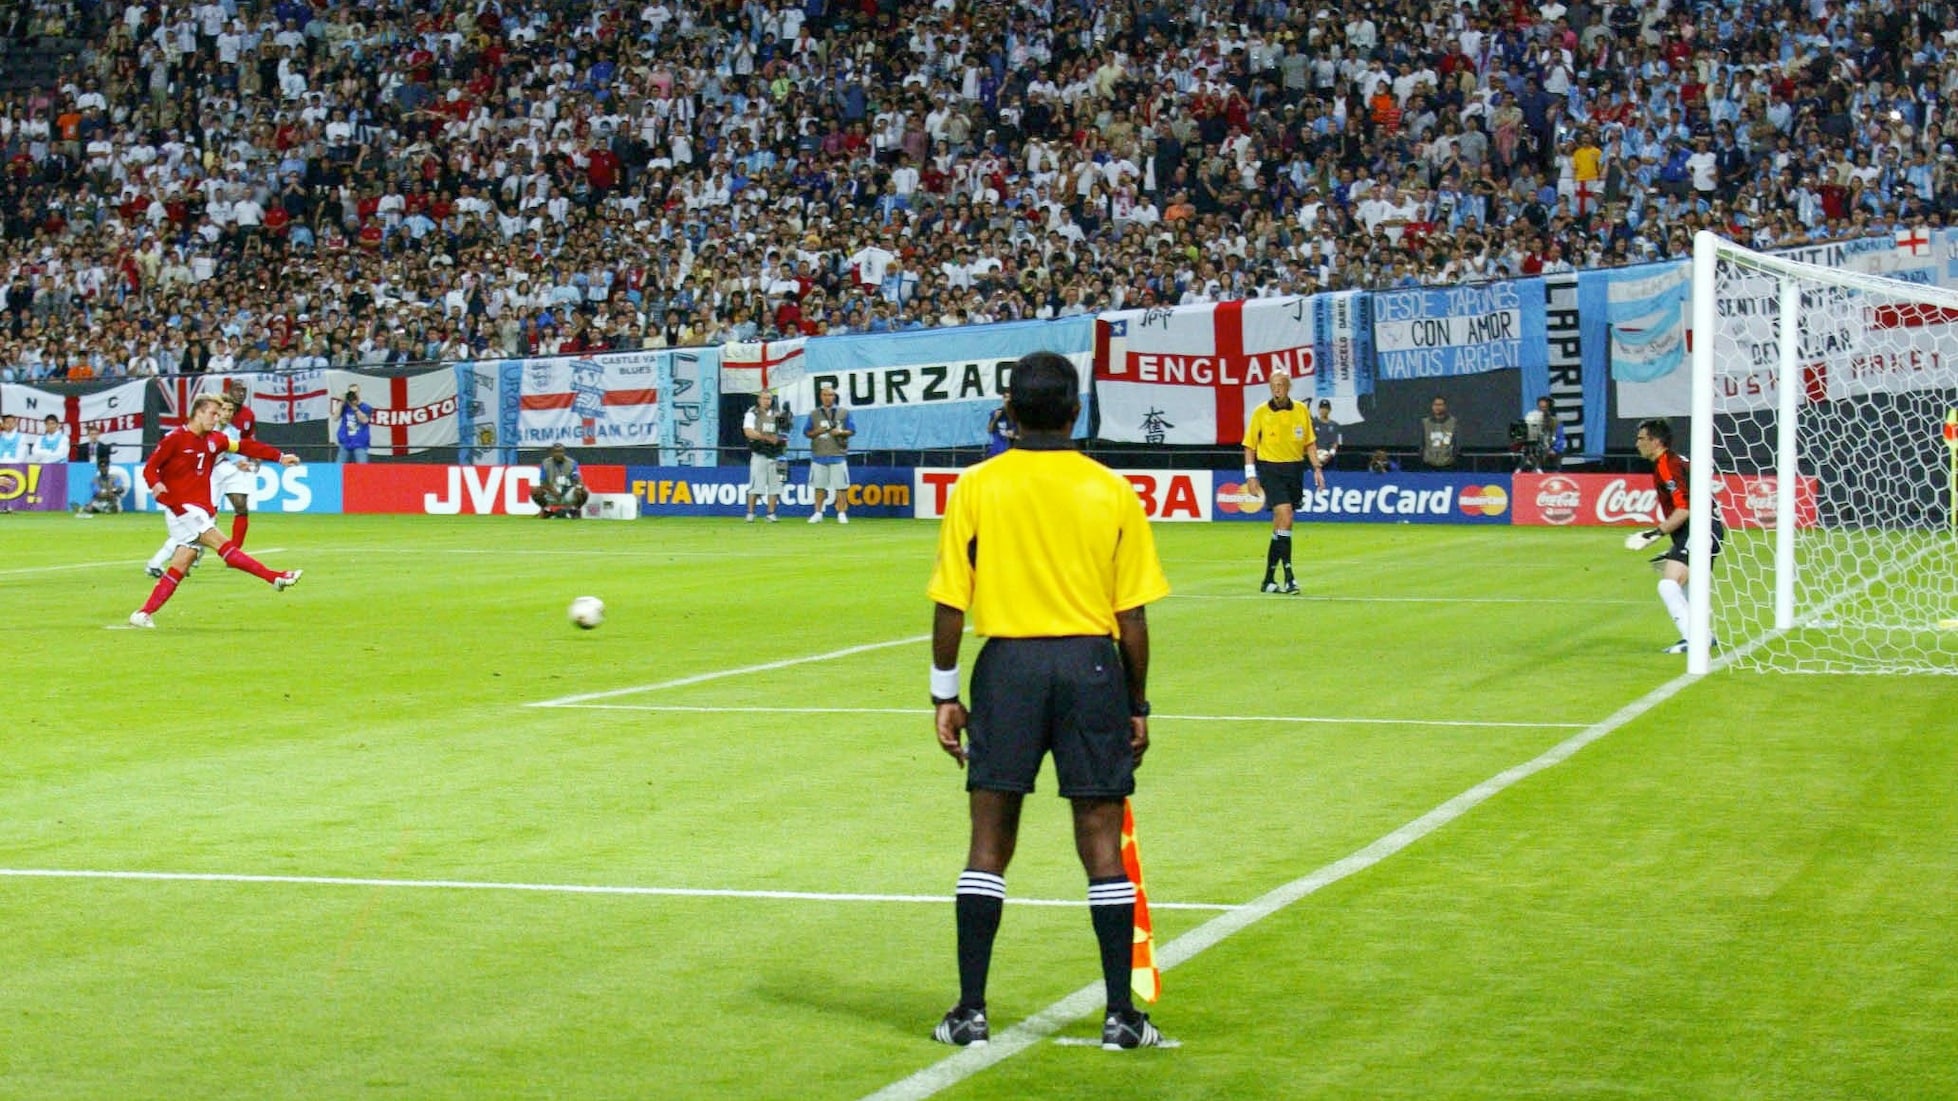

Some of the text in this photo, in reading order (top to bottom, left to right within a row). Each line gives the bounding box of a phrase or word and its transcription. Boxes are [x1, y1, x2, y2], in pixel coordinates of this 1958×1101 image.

[1374, 290, 1434, 321] DESDE
[1411, 311, 1513, 347] CON AMOR
[1138, 347, 1315, 385] ENGLAND
[1384, 350, 1446, 379] VAMOS
[369, 397, 459, 425] RINGTO
[197, 452, 205, 470] 7
[424, 466, 541, 514] JVC
[1296, 485, 1453, 514] asterCard
